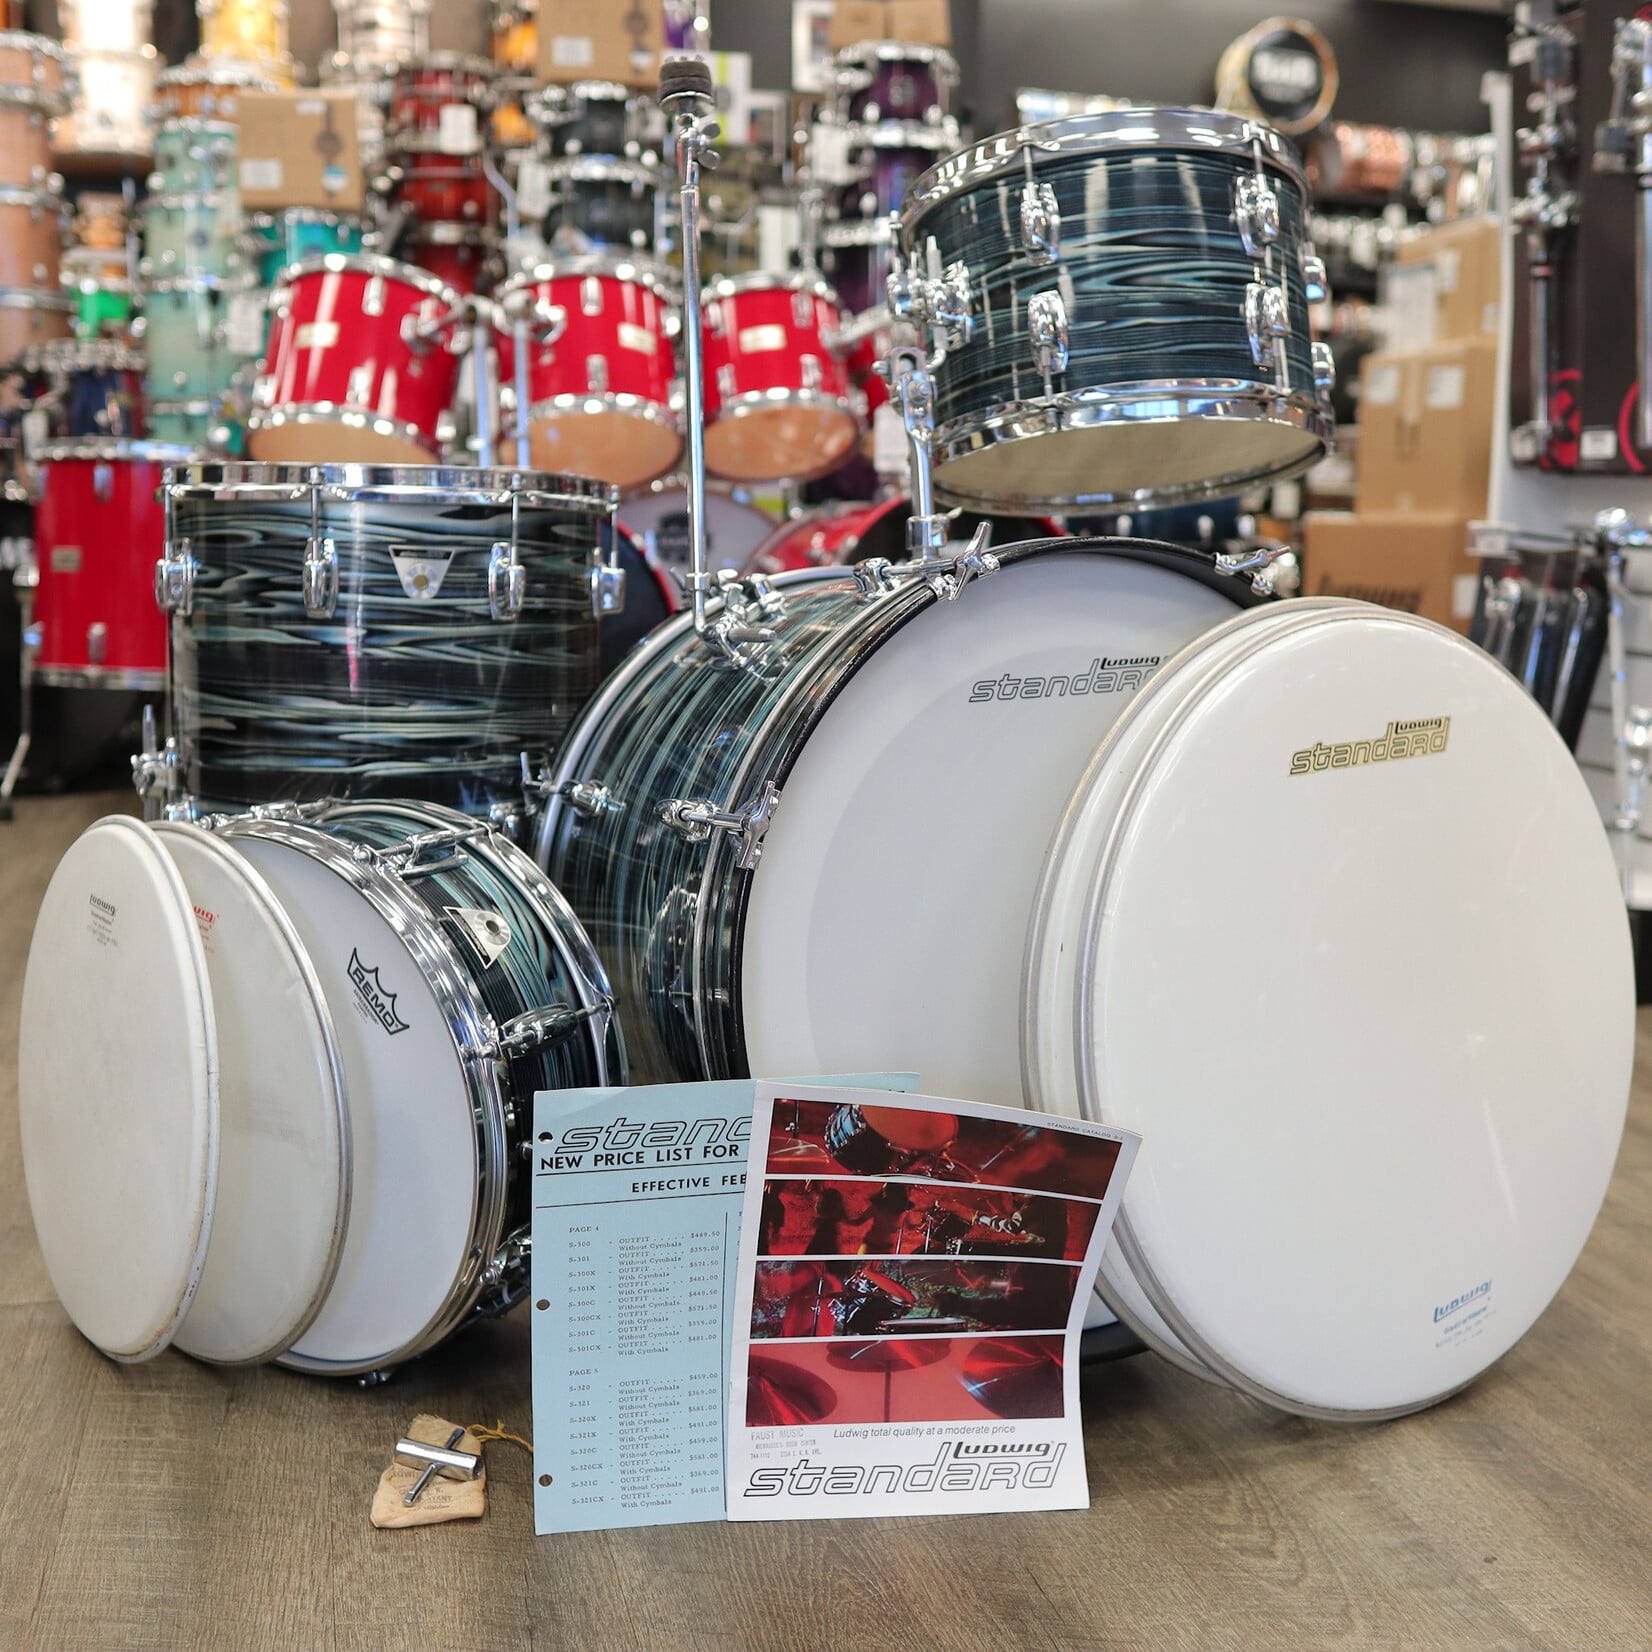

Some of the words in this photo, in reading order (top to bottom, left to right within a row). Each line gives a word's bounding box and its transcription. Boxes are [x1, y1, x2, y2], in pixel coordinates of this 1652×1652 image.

[352, 966, 396, 1028] REMO
[540, 1155, 583, 1171] NEW
[593, 1151, 645, 1167] PRICE
[656, 1147, 693, 1163] LIST
[703, 1144, 740, 1159] FOR
[632, 1176, 710, 1193] EFFECTIVE
[619, 1236, 650, 1244] OUTFIT
[650, 1256, 681, 1264] Cymbals
[637, 1316, 669, 1324] Cymbals
[648, 1330, 680, 1339] Cymbals
[620, 1379, 650, 1387] OUTFIT
[648, 1385, 679, 1393] Cymbals
[618, 1395, 648, 1403] OUTFIT
[648, 1401, 680, 1409] Cymbals
[618, 1411, 649, 1419] OUTFIT
[619, 1427, 649, 1435] OUTFIT
[751, 1430, 775, 1441] FAUST
[779, 1428, 804, 1438] MUSIC
[833, 1428, 868, 1439] Ludwig
[870, 1427, 891, 1437] total
[893, 1426, 925, 1437] quality
[926, 1427, 936, 1435] at
[945, 1425, 989, 1435] moderate
[991, 1425, 1016, 1436] price
[619, 1443, 649, 1451] OUTFIT
[952, 1441, 1052, 1459] Ludwig
[650, 1449, 680, 1457] Cymbals
[620, 1459, 650, 1467] OUTFIT
[639, 1466, 670, 1474] Cymbals
[743, 1441, 1067, 1497] standard
[650, 1482, 682, 1490] Cymbals
[621, 1492, 650, 1500] OUTFIT
[640, 1499, 671, 1508] Cymbals
